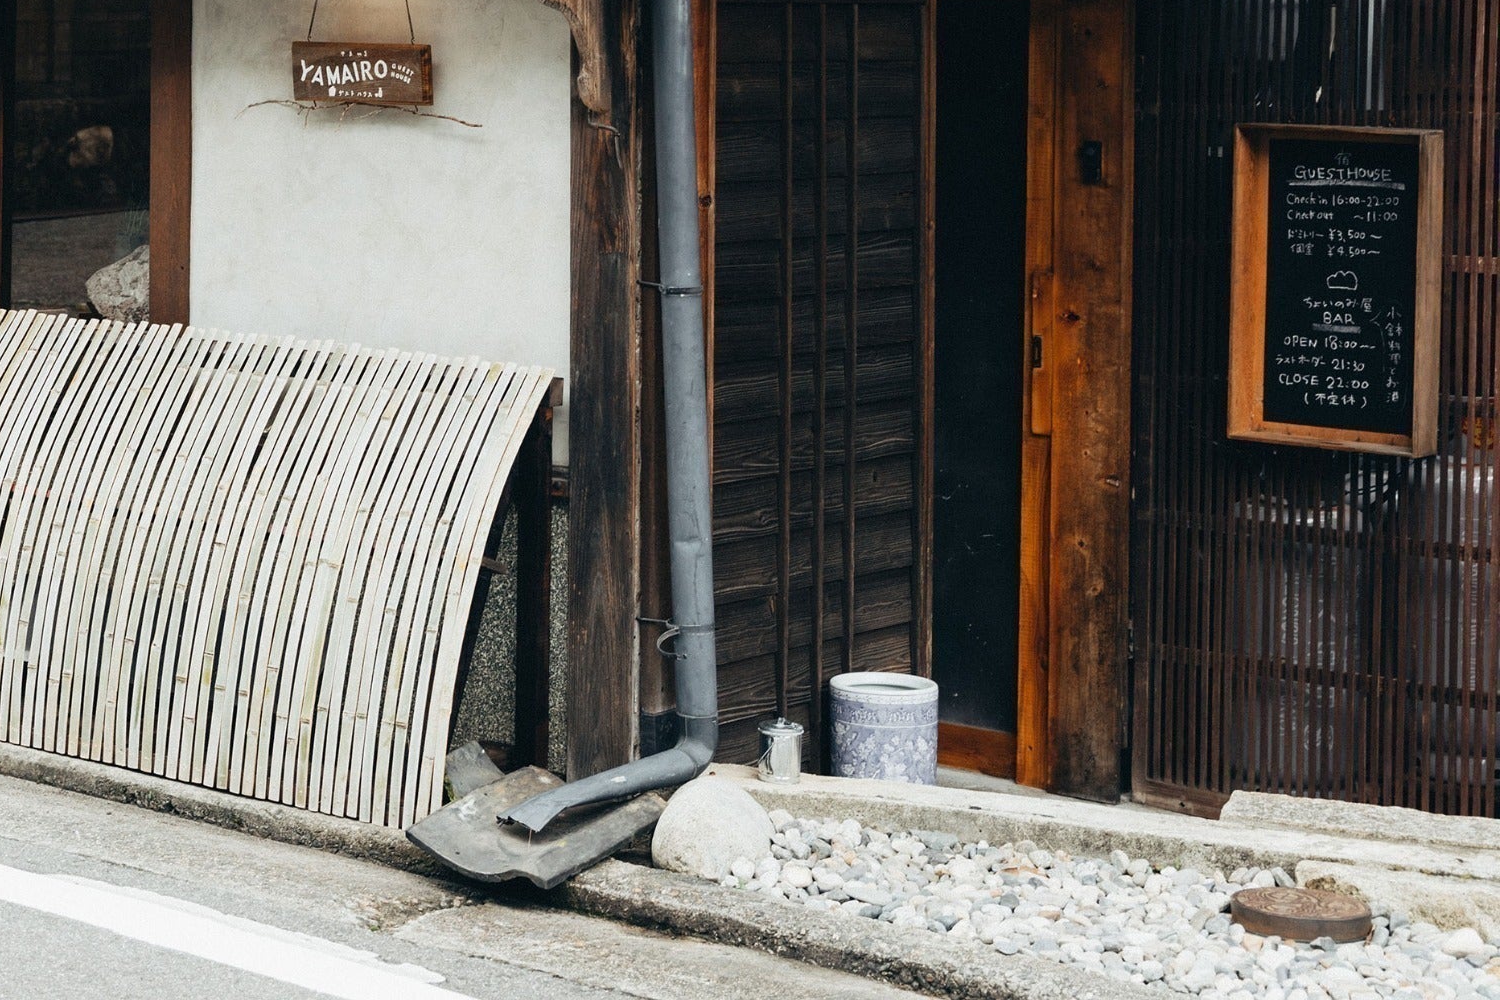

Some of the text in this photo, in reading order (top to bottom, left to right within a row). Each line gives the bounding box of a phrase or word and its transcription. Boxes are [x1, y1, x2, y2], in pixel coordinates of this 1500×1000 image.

[300, 59, 388, 86] YAMAIRO
[390, 71, 412, 84] HOUSE
[391, 63, 415, 78] GUEST
[1286, 193, 1400, 208] Check in 16:00-22:00
[1286, 209, 1314, 220] Check
[1316, 211, 1334, 220] out
[1303, 297, 1373, 313] ちょいのみ屋
[1323, 311, 1356, 325] BAR
[1283, 335, 1318, 348] OPEN
[1331, 358, 1366, 372] 21:30
[1278, 373, 1370, 390] CLOSE 22:00
